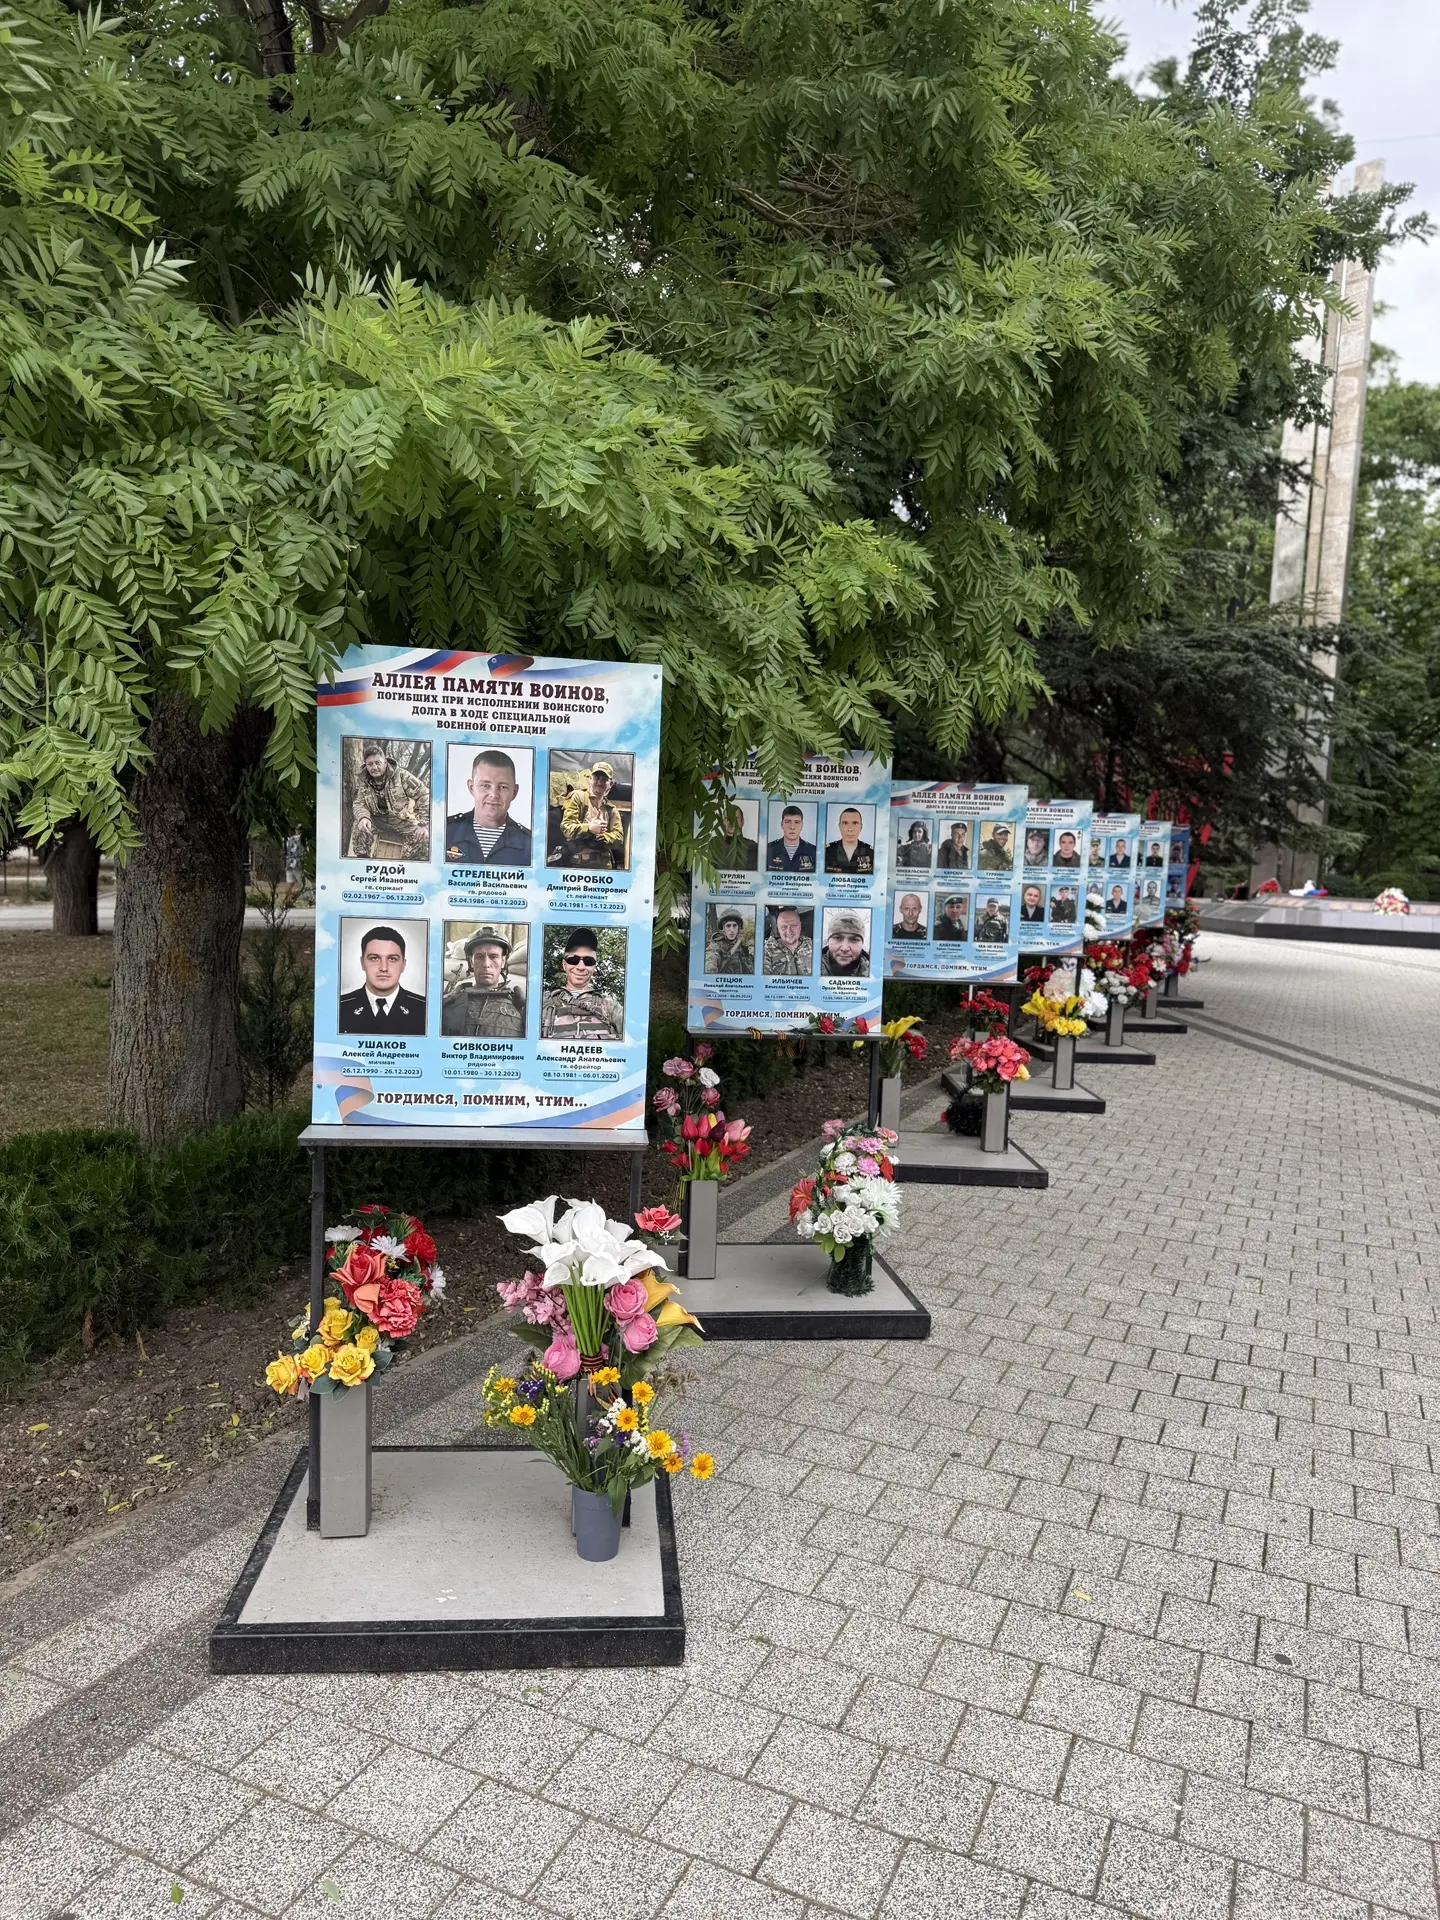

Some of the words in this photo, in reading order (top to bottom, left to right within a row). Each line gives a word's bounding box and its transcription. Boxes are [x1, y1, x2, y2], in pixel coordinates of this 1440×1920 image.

[372, 672, 436, 691] АЛЛЕЯ
[443, 677, 523, 696] ПАМЯТИ
[530, 683, 609, 704] ВОИНОВ,
[377, 691, 438, 703] ПОГИБШИХ
[442, 696, 464, 705] ПРИ
[467, 697, 539, 710] ИСПОЛНЕНИИ
[543, 702, 604, 713] ВОИНСКОГО
[412, 706, 447, 716] ДОЛГА
[460, 709, 489, 720] ХОДЕ
[492, 711, 570, 724] СПЕЦИАЛЬНОЙ
[436, 720, 487, 731] ВОЕННОЙ
[490, 723, 546, 735] ОПЕРАЦИИ
[816, 764, 862, 776] ВОИНОВ,
[911, 791, 936, 799] АЛЛЕЯ
[938, 792, 971, 800] ПАМЯТИ
[365, 864, 405, 876] РУДОЙ
[451, 869, 525, 881] СТРЕЛЕЦКИЙ
[350, 875, 377, 884] Сергей
[379, 876, 418, 885] Иванович
[562, 874, 613, 884] КОРОБКО
[482, 881, 528, 889] Васильевич
[547, 884, 581, 893] Дмитрий
[583, 886, 628, 894] Викторович
[725, 1010, 772, 1018] ГОРДИМСЯ,
[358, 1040, 407, 1050] УШАКОВ
[453, 1042, 513, 1052] СИВКОВИЧ
[561, 1045, 603, 1055] НАДЕЕВ
[376, 1051, 419, 1059] Андреевич
[441, 1052, 467, 1060] Виктор
[469, 1053, 524, 1061] Владимирович
[536, 1054, 576, 1063] Александр
[377, 1093, 458, 1107] ГОРДИМСЯ,
[462, 1094, 530, 1108] ПОМНИМ,
[534, 1095, 588, 1108] ЧТИМ...
